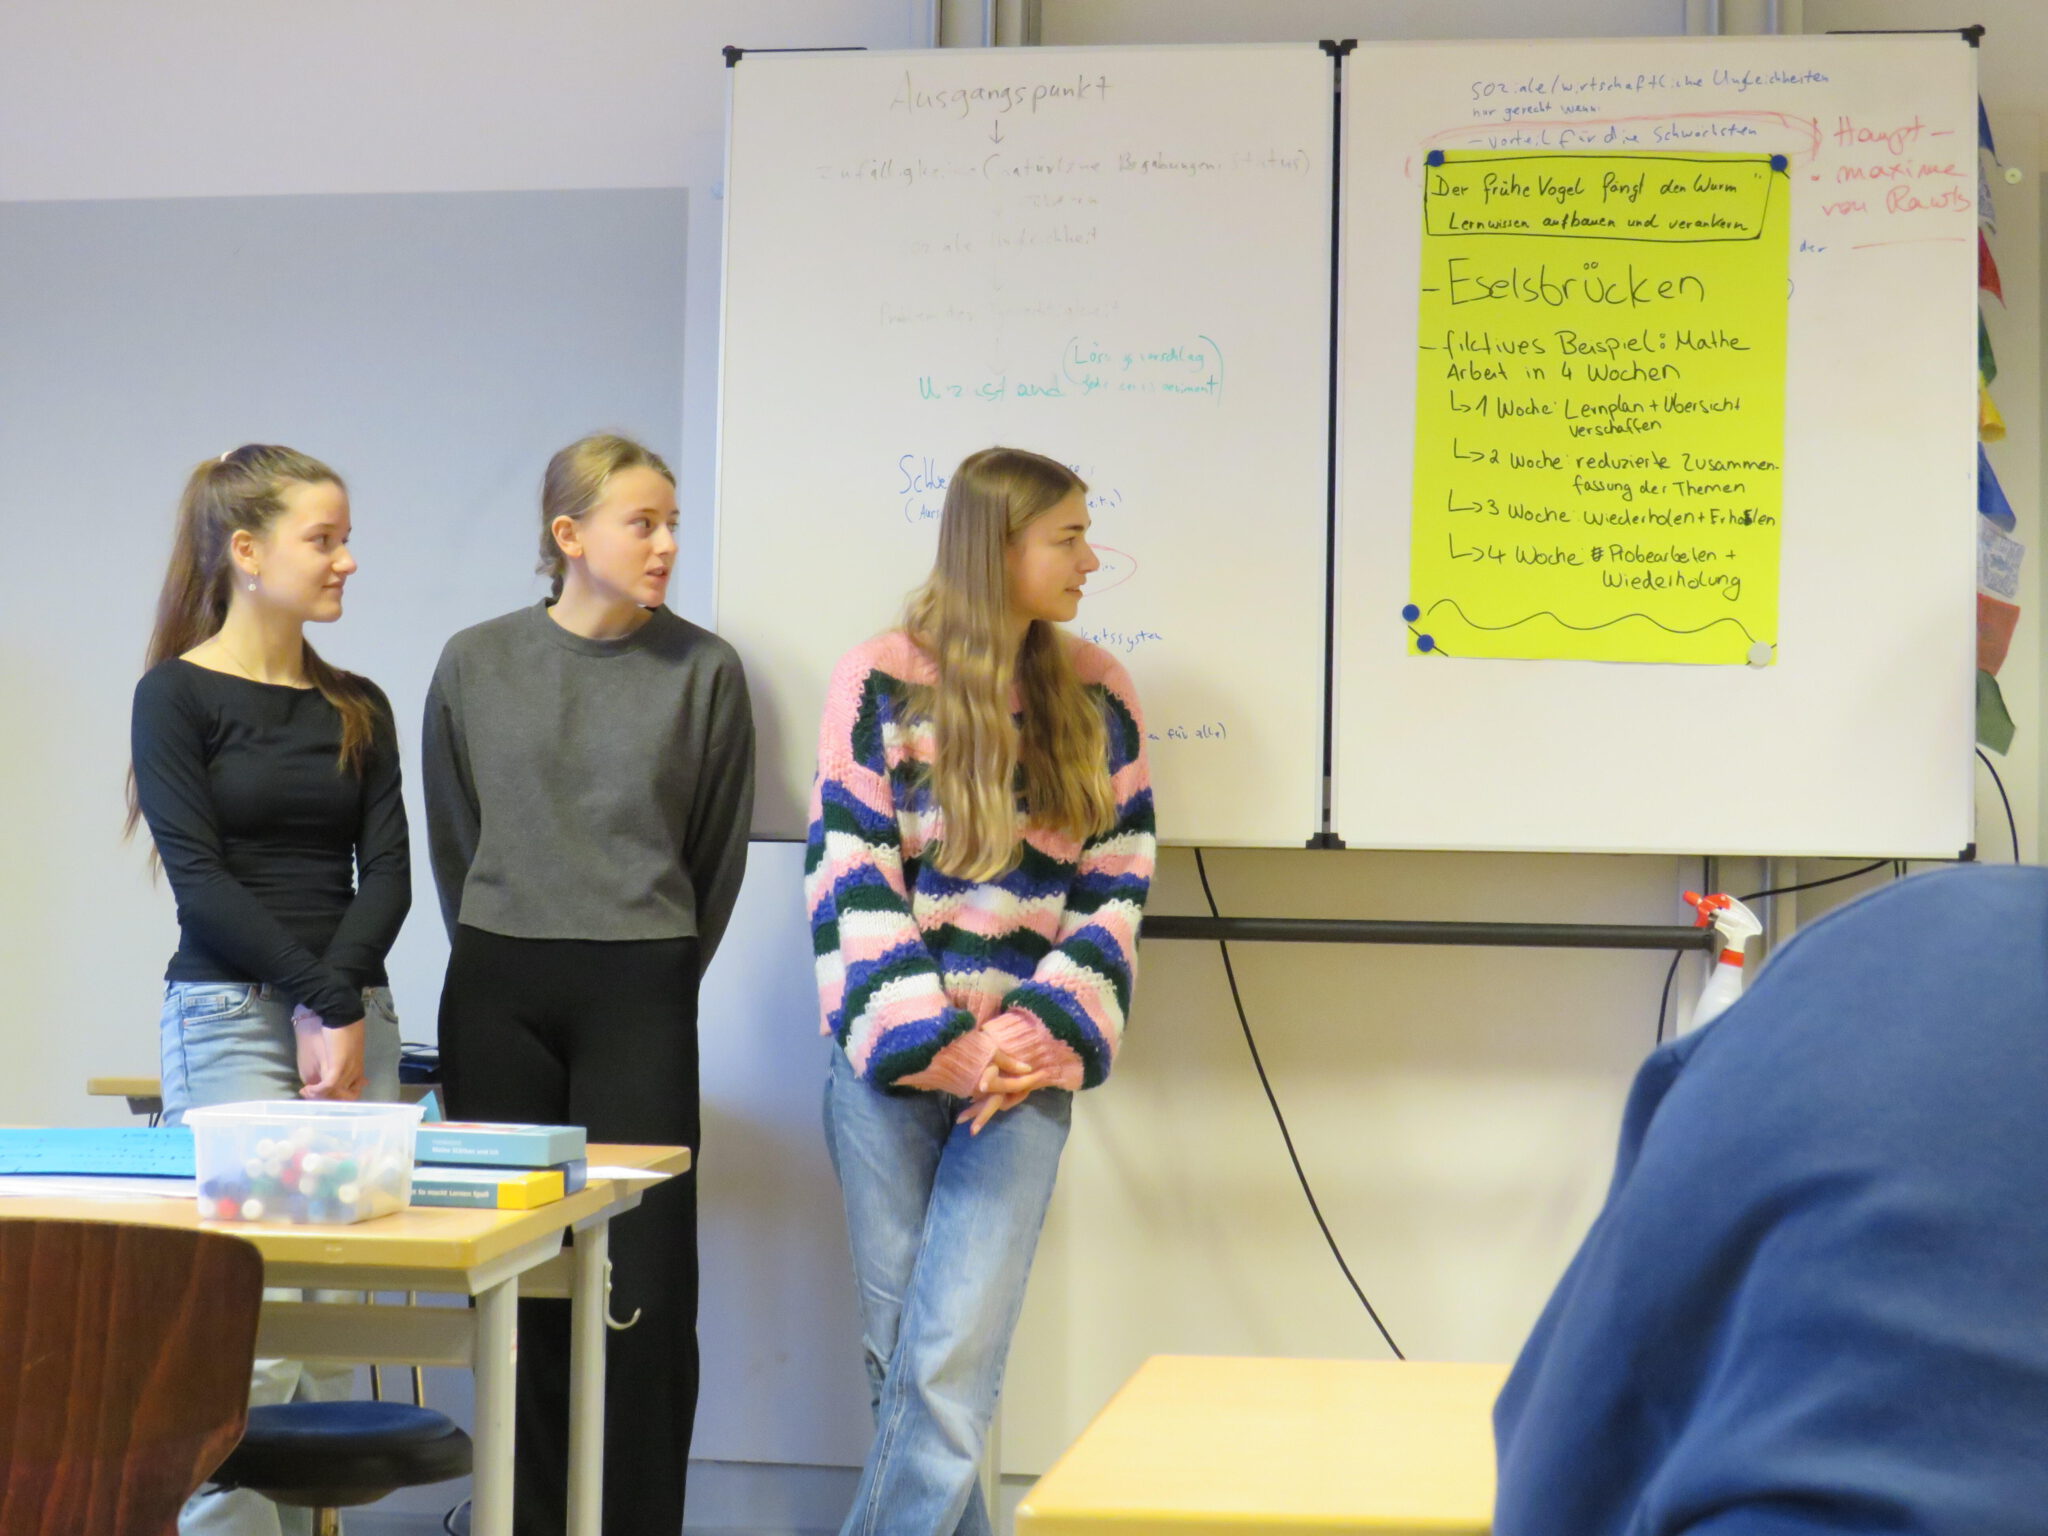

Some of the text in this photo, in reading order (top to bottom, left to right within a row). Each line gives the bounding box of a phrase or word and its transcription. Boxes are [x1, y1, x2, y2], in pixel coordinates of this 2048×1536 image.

[890, 70, 1113, 117] Ausgangspunkt
[1472, 107, 1497, 118] nur
[1503, 101, 1552, 122] gerecht
[1560, 128, 1596, 150] für
[1603, 125, 1640, 145] die
[1430, 174, 1469, 197] Der
[1483, 172, 1531, 205] frühe
[1538, 175, 1585, 205] Vogel
[1660, 178, 1687, 196] den
[1448, 210, 1749, 232] Lernwissen aufbauen und verankern
[1821, 200, 1868, 218] von
[1448, 257, 1705, 308] Eselsbrücken
[1442, 329, 1546, 361] fiktives
[1675, 329, 1752, 352] Mathe
[1446, 359, 1681, 383] Arbeit in 4 Wochen
[1475, 394, 1489, 417] 1
[1564, 393, 1645, 422] Lernplan
[1489, 448, 1500, 465] 2
[1575, 450, 1671, 471] reduzierte
[1573, 474, 1746, 502] fassung der Themen
[1486, 498, 1500, 516] 3
[1487, 544, 1507, 565] 4
[1602, 568, 1742, 602] Wiederholung
